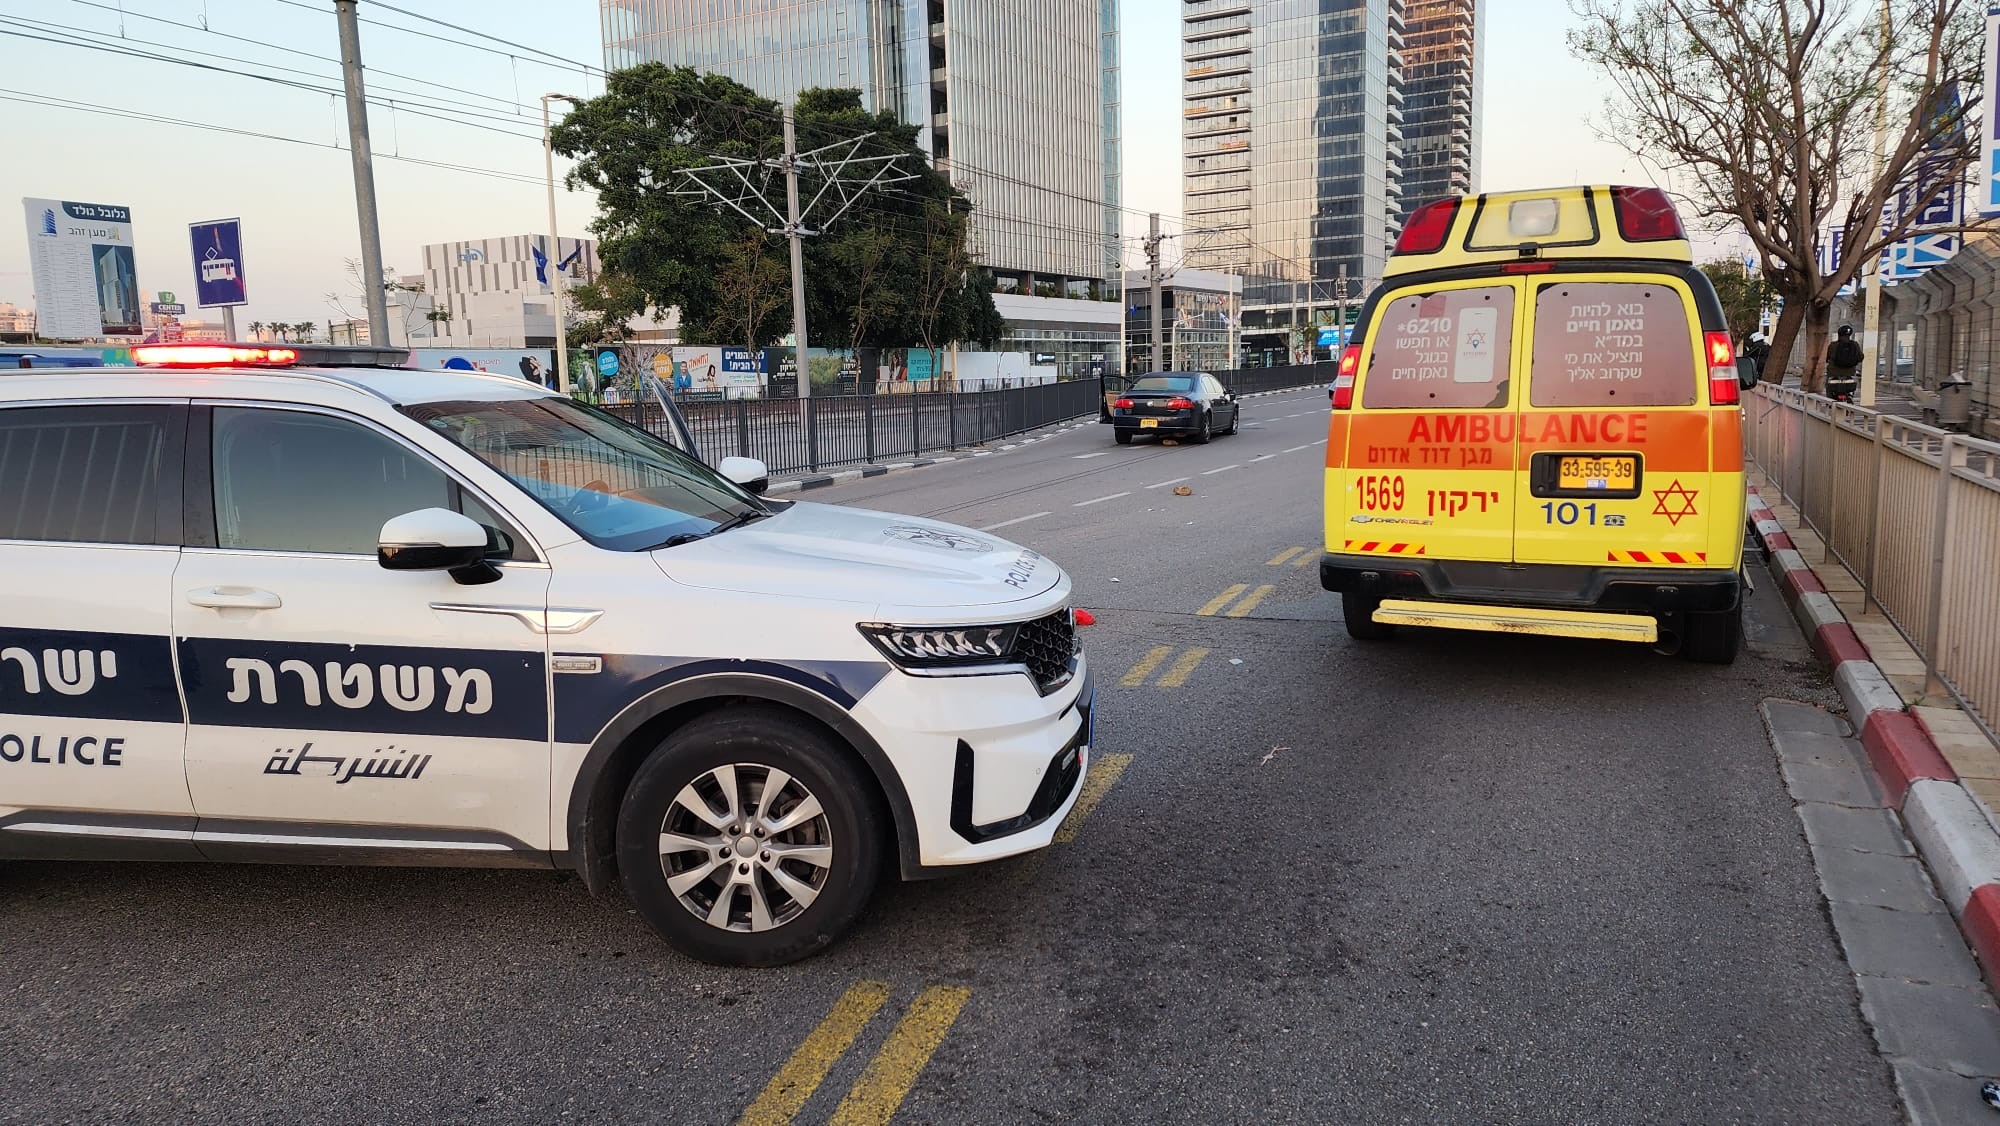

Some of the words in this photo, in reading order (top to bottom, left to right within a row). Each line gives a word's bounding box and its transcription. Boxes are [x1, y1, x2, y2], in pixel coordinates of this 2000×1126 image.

[72, 205, 95, 216] גולד
[98, 206, 126, 219] גלובל
[1570, 301, 1612, 318] להיות
[1617, 303, 1645, 315] בוא
[1567, 320, 1600, 332] חיים
[1606, 318, 1644, 334] נאמן
[1396, 336, 1431, 349] חפשו
[1436, 336, 1450, 348] או
[725, 351, 754, 360] המרים
[1415, 350, 1448, 364] בגוגל
[1565, 352, 1578, 364] מי
[1582, 352, 1602, 364] את
[1607, 349, 1642, 364] ותציל
[1392, 367, 1416, 380] חיים
[1419, 366, 1448, 381] נאמן
[1567, 366, 1596, 382] אליך
[1600, 367, 1642, 381] שקרוב
[1408, 413, 1648, 444] AMBULANCE
[1368, 445, 1410, 464] אדום
[1419, 447, 1451, 464] דוד
[1460, 447, 1493, 467] מגן
[1356, 475, 1405, 511] 1569
[1427, 490, 1499, 517] ירקון
[1374, 517, 1434, 526] CHEVROLET
[1540, 502, 1597, 526] 101
[1004, 558, 1036, 590] POLICE
[226, 657, 493, 714] משטרת
[264, 743, 432, 784] الشرطة
